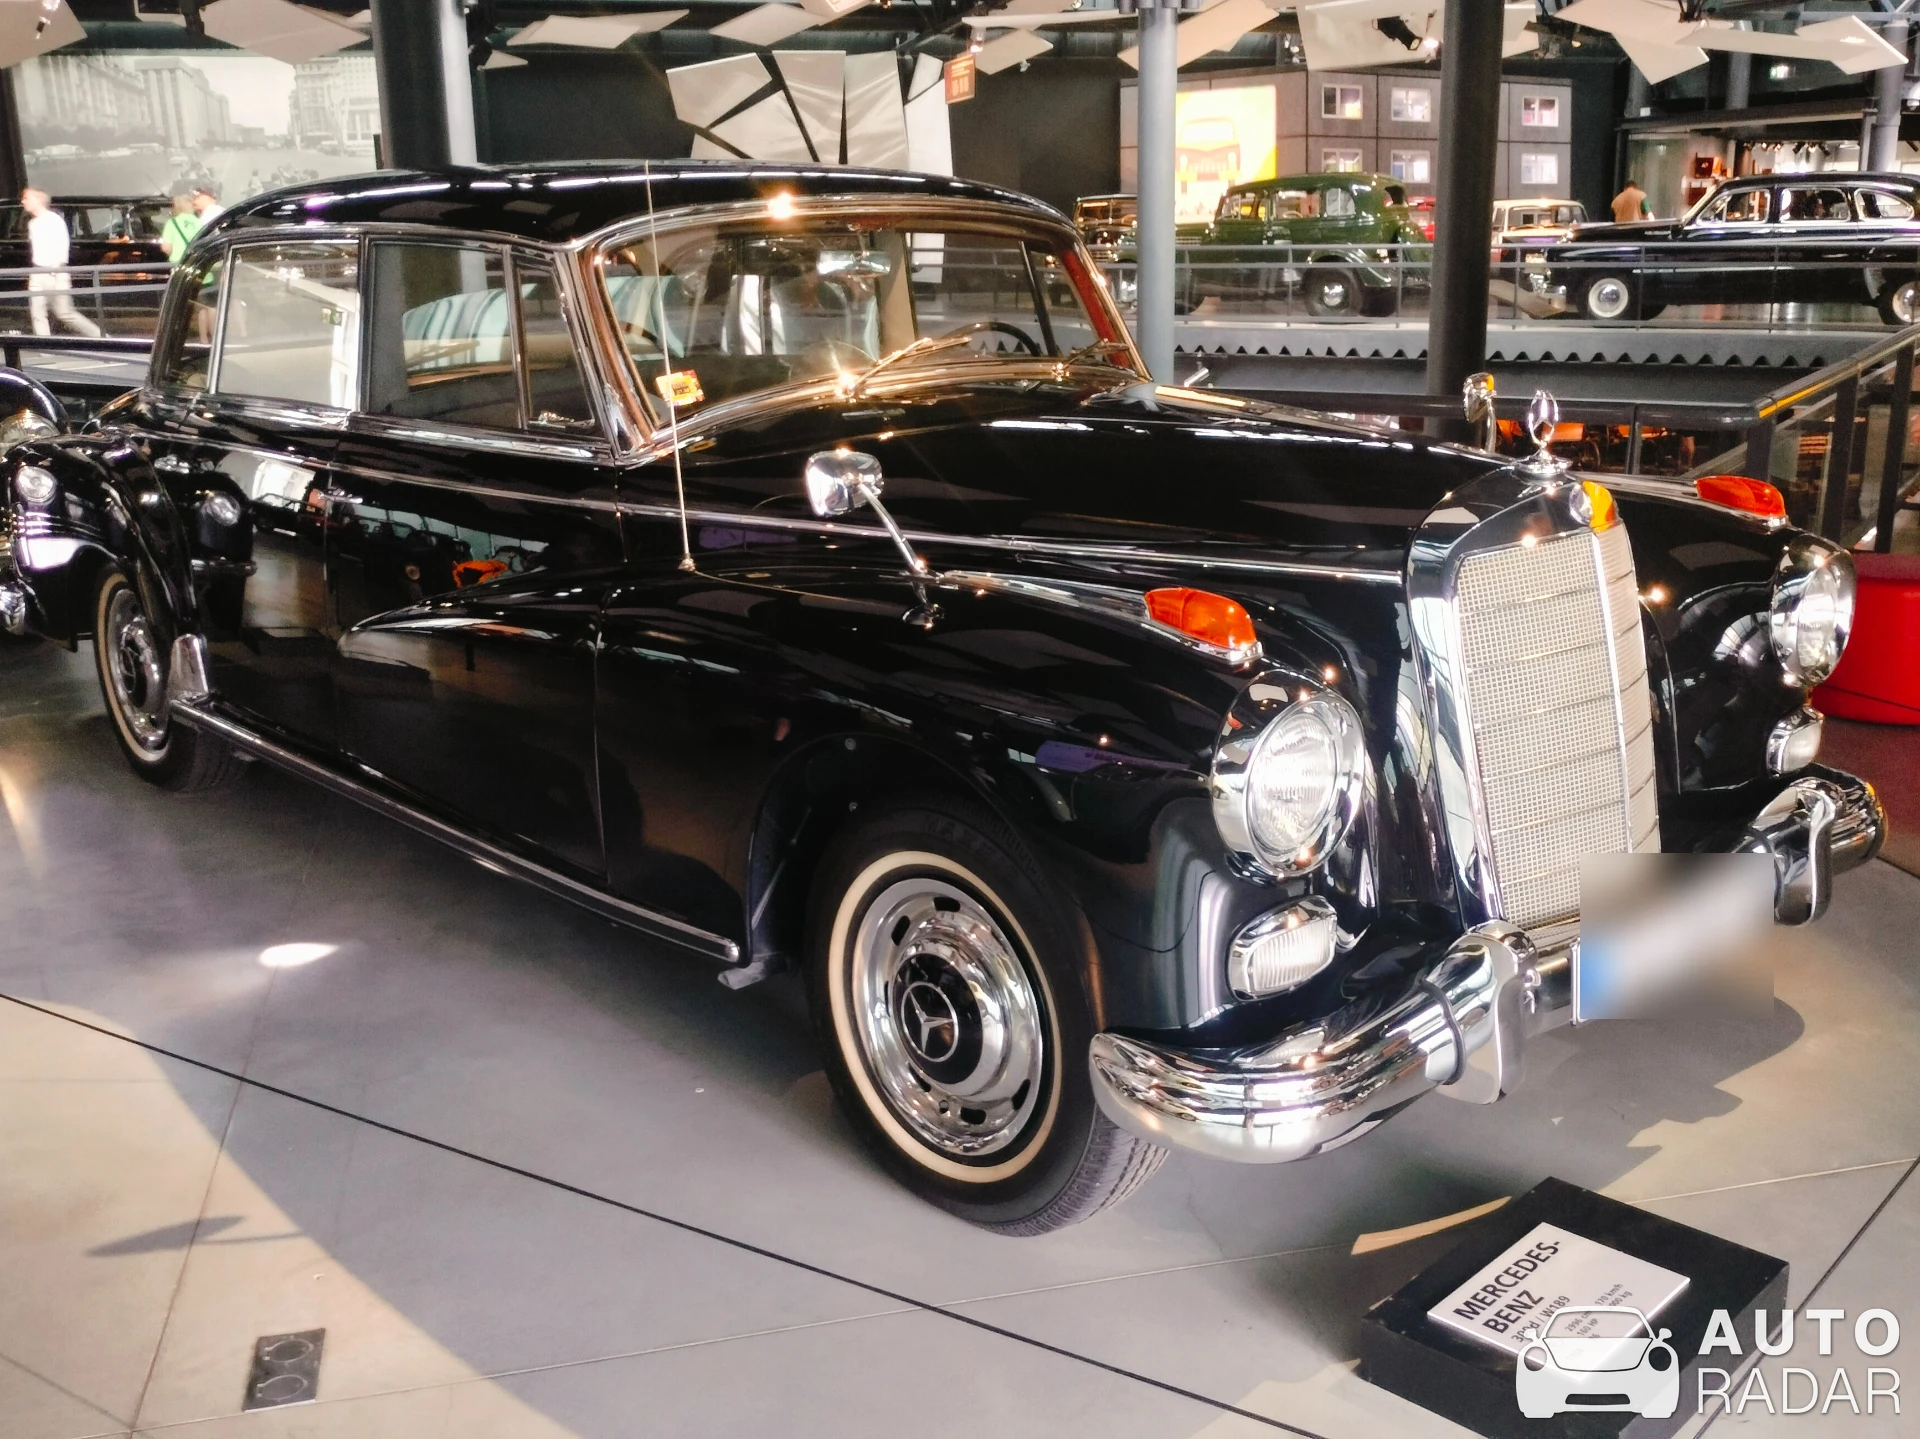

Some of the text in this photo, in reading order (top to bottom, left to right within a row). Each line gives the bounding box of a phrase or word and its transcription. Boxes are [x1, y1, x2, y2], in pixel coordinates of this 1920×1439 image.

[1452, 1241, 1560, 1320] MERCEDES-
[1482, 1290, 1545, 1334] BENZ
[1539, 1295, 1571, 1319] W189
